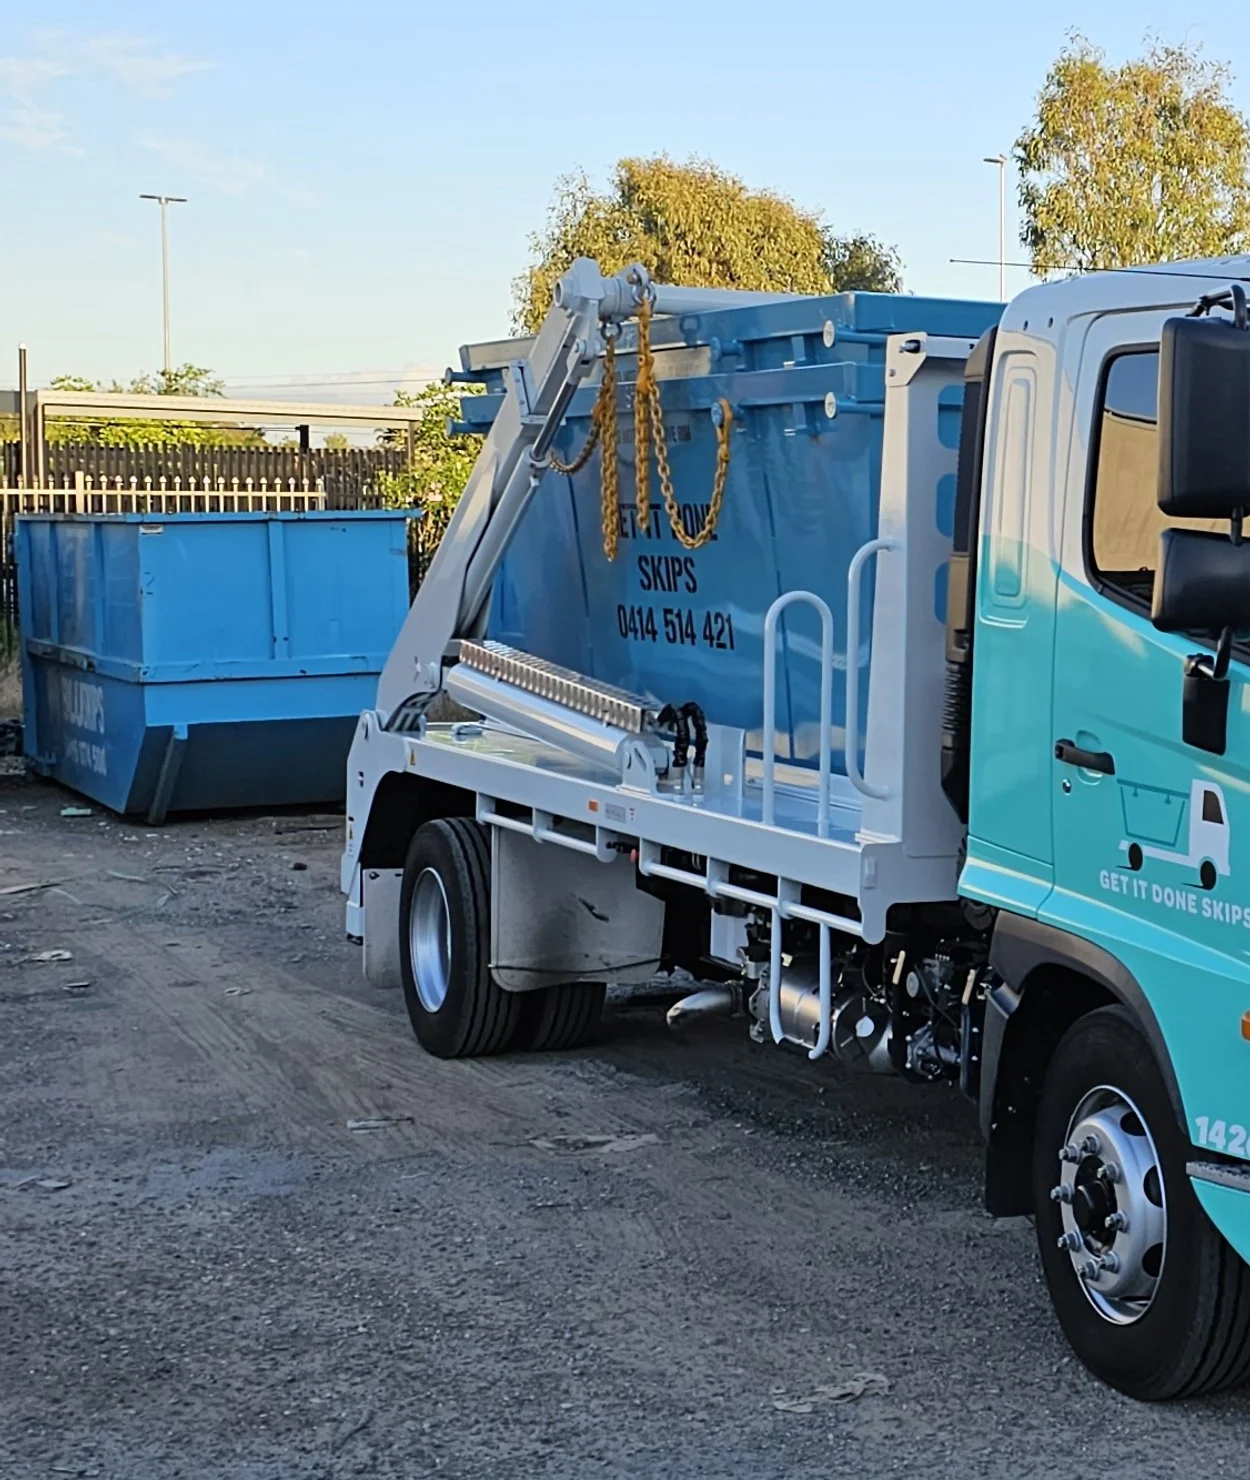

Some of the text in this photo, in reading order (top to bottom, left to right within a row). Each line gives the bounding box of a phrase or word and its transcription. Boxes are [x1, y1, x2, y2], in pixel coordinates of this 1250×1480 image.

[637, 554, 698, 594] SKIPS
[617, 603, 735, 651] 0414 514 421
[1099, 870, 1130, 895] GET
[1132, 877, 1149, 900] IT
[1151, 883, 1198, 915] DONE
